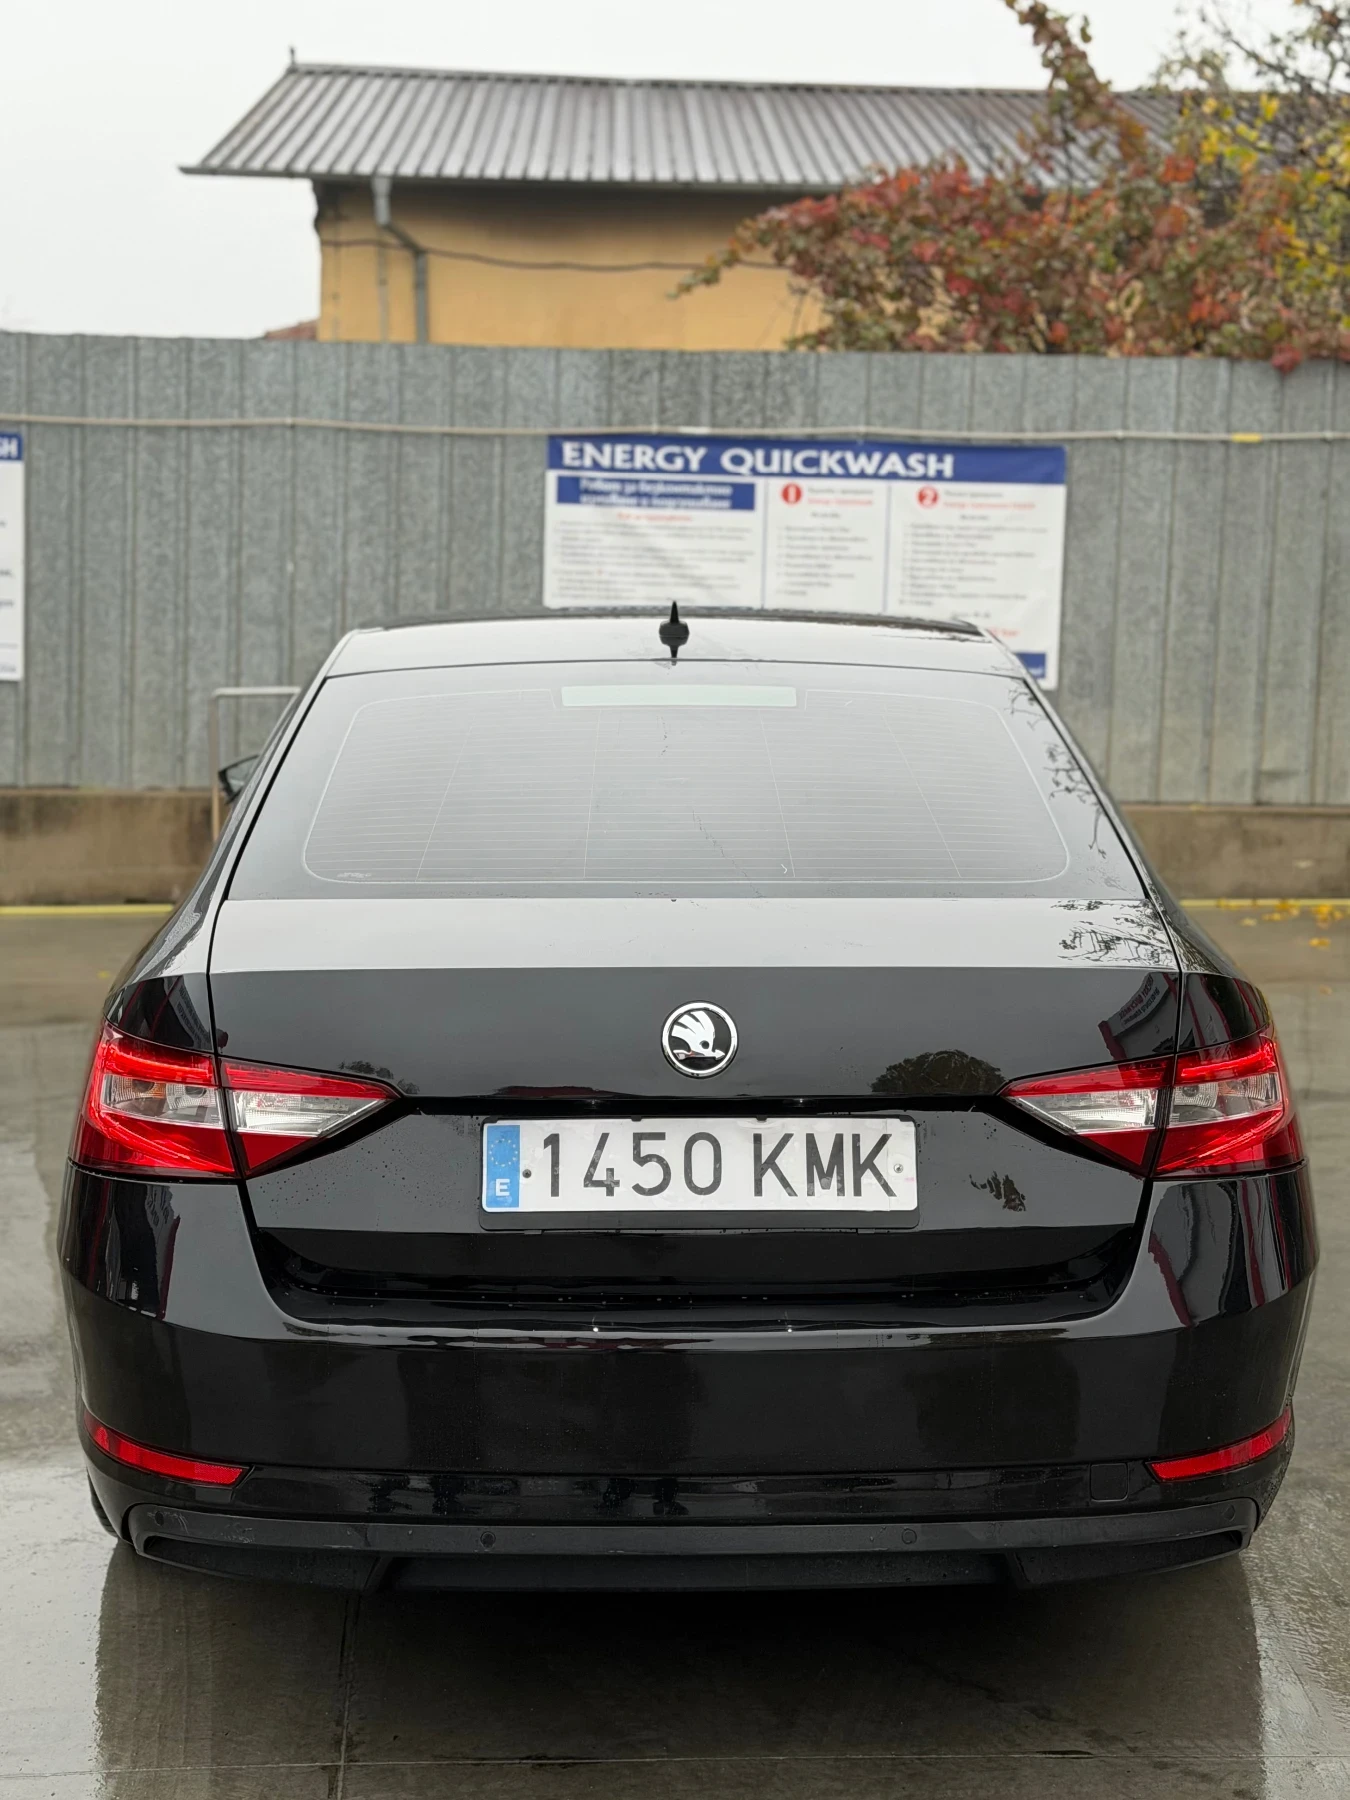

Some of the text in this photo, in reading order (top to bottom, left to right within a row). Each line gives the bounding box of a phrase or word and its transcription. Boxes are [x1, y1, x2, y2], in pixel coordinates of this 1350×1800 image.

[562, 442, 954, 478] ENERGY QUICKWASH
[543, 1132, 897, 1198] 1450 KMK
[495, 1179, 510, 1196] E
